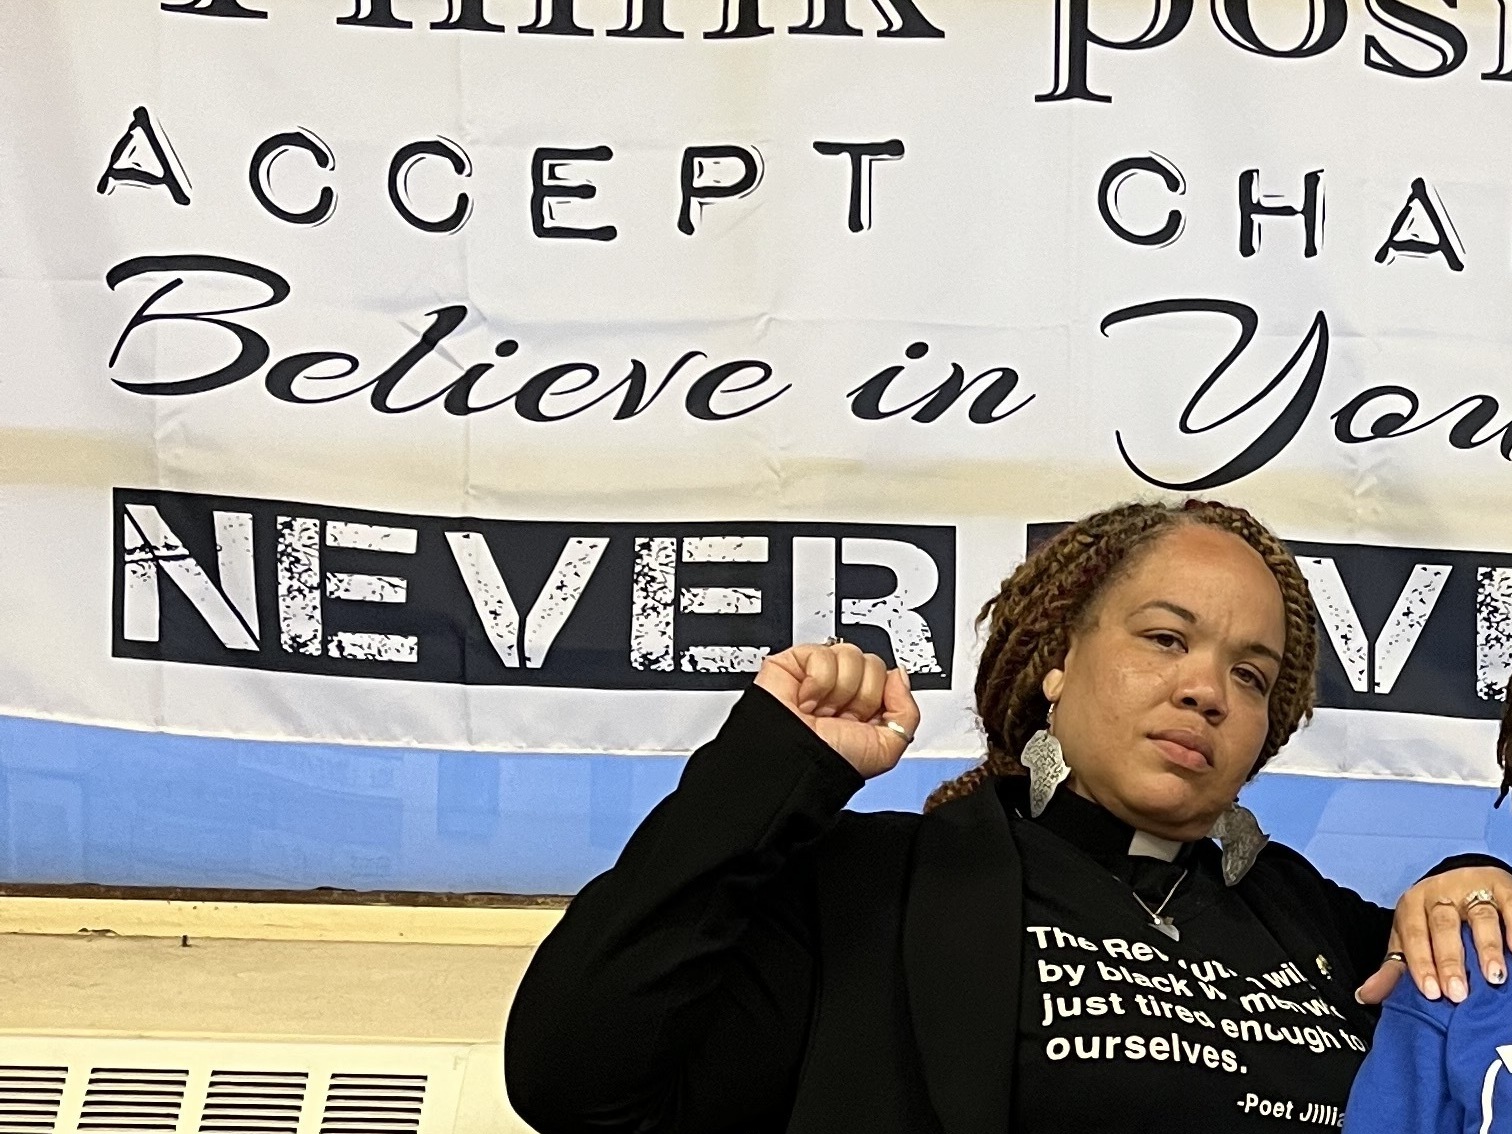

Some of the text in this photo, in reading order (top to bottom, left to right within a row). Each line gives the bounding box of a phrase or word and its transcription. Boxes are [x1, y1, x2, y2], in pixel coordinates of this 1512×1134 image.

[96, 105, 906, 242] ACCEPT
[105, 254, 794, 423] Believe
[846, 341, 1037, 424] in
[122, 503, 947, 679] NEVER
[1026, 926, 1099, 951] The
[1037, 958, 1086, 987] by
[1096, 960, 1194, 997] black
[1041, 992, 1126, 1027] just
[1220, 1018, 1342, 1053] enough
[1045, 1032, 1248, 1074] ourselves.
